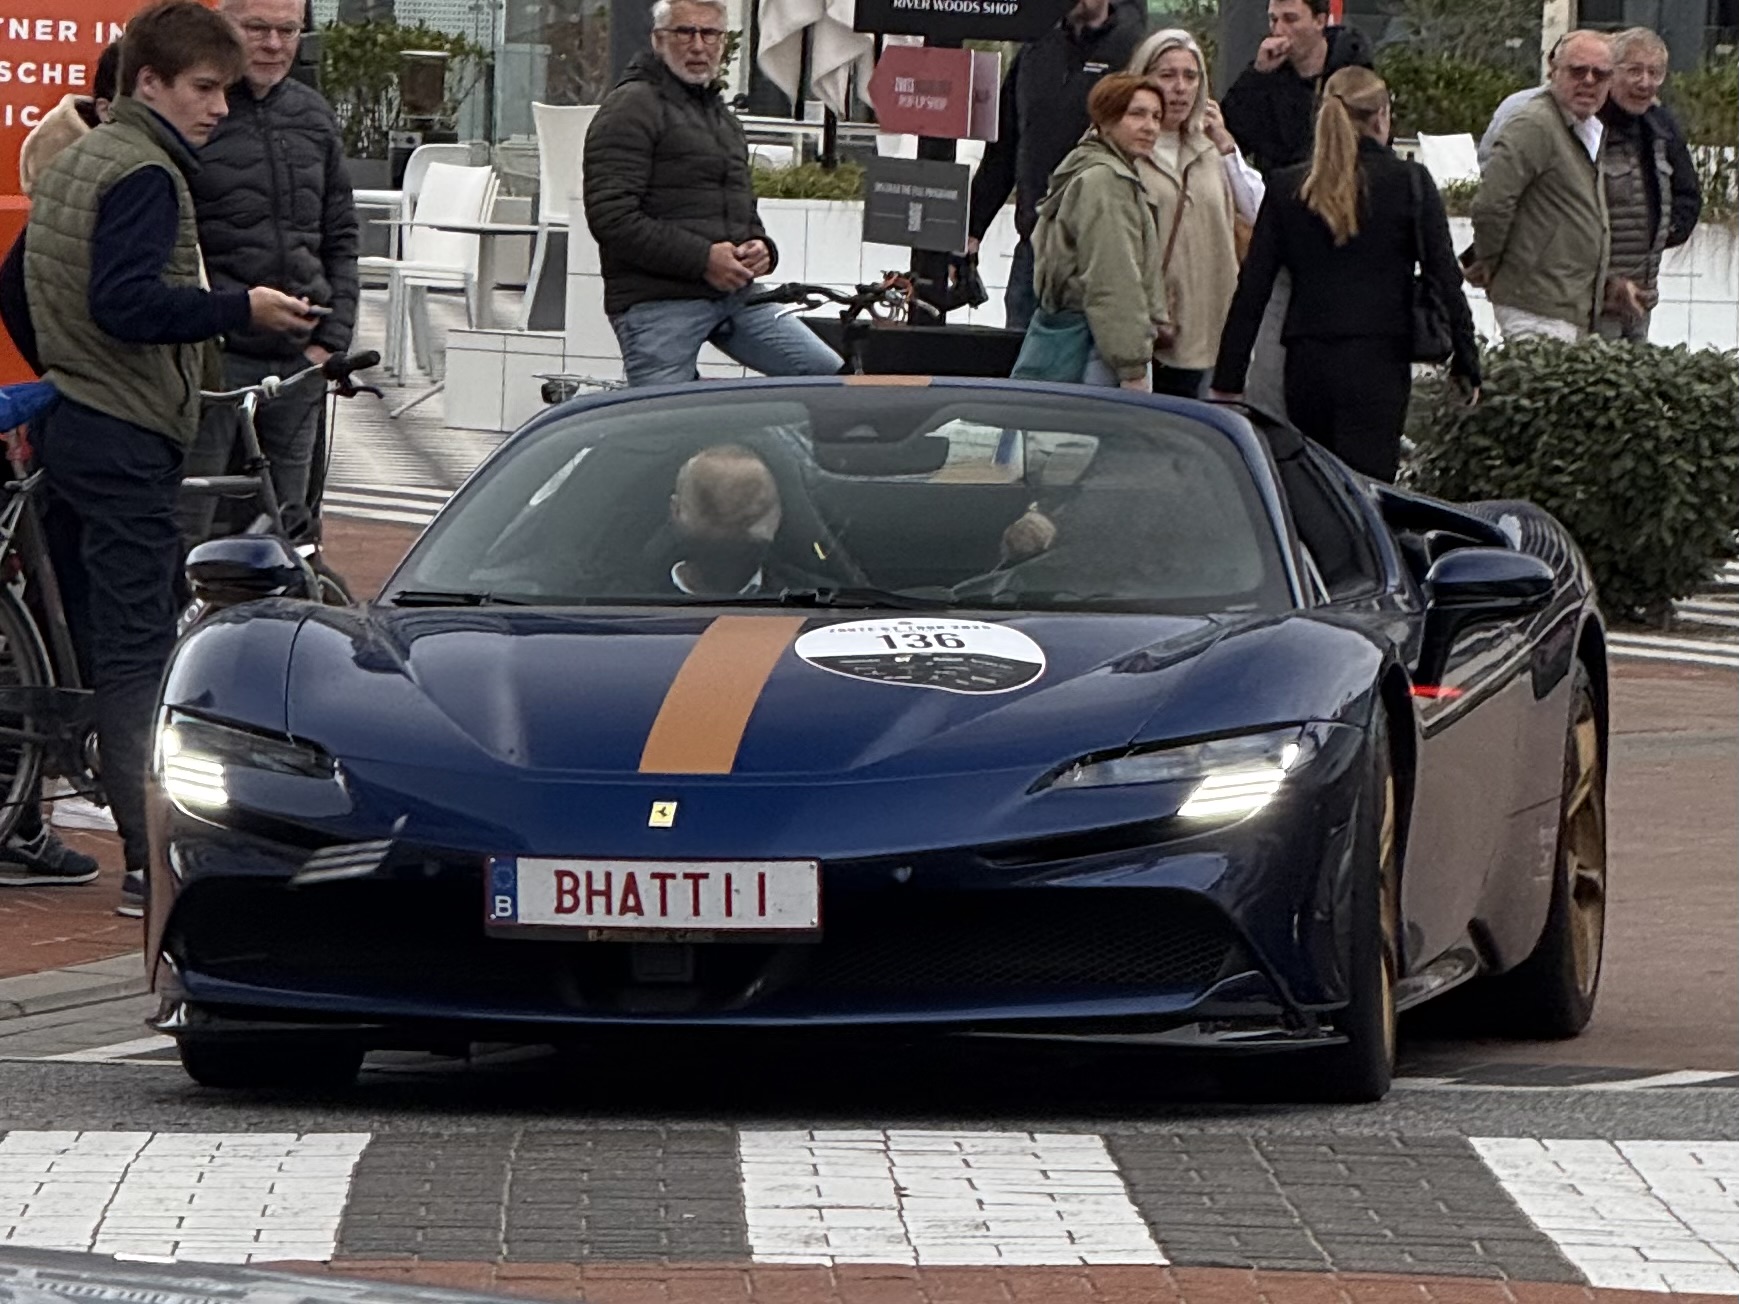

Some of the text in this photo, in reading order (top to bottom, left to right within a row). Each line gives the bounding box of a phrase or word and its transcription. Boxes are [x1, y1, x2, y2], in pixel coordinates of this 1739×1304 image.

[893, 0, 1018, 15] RIVER WOODS SHOP
[0, 18, 77, 42] NER
[876, 633, 966, 649] 136
[554, 869, 766, 917] BHATTII
[494, 895, 512, 917] B
